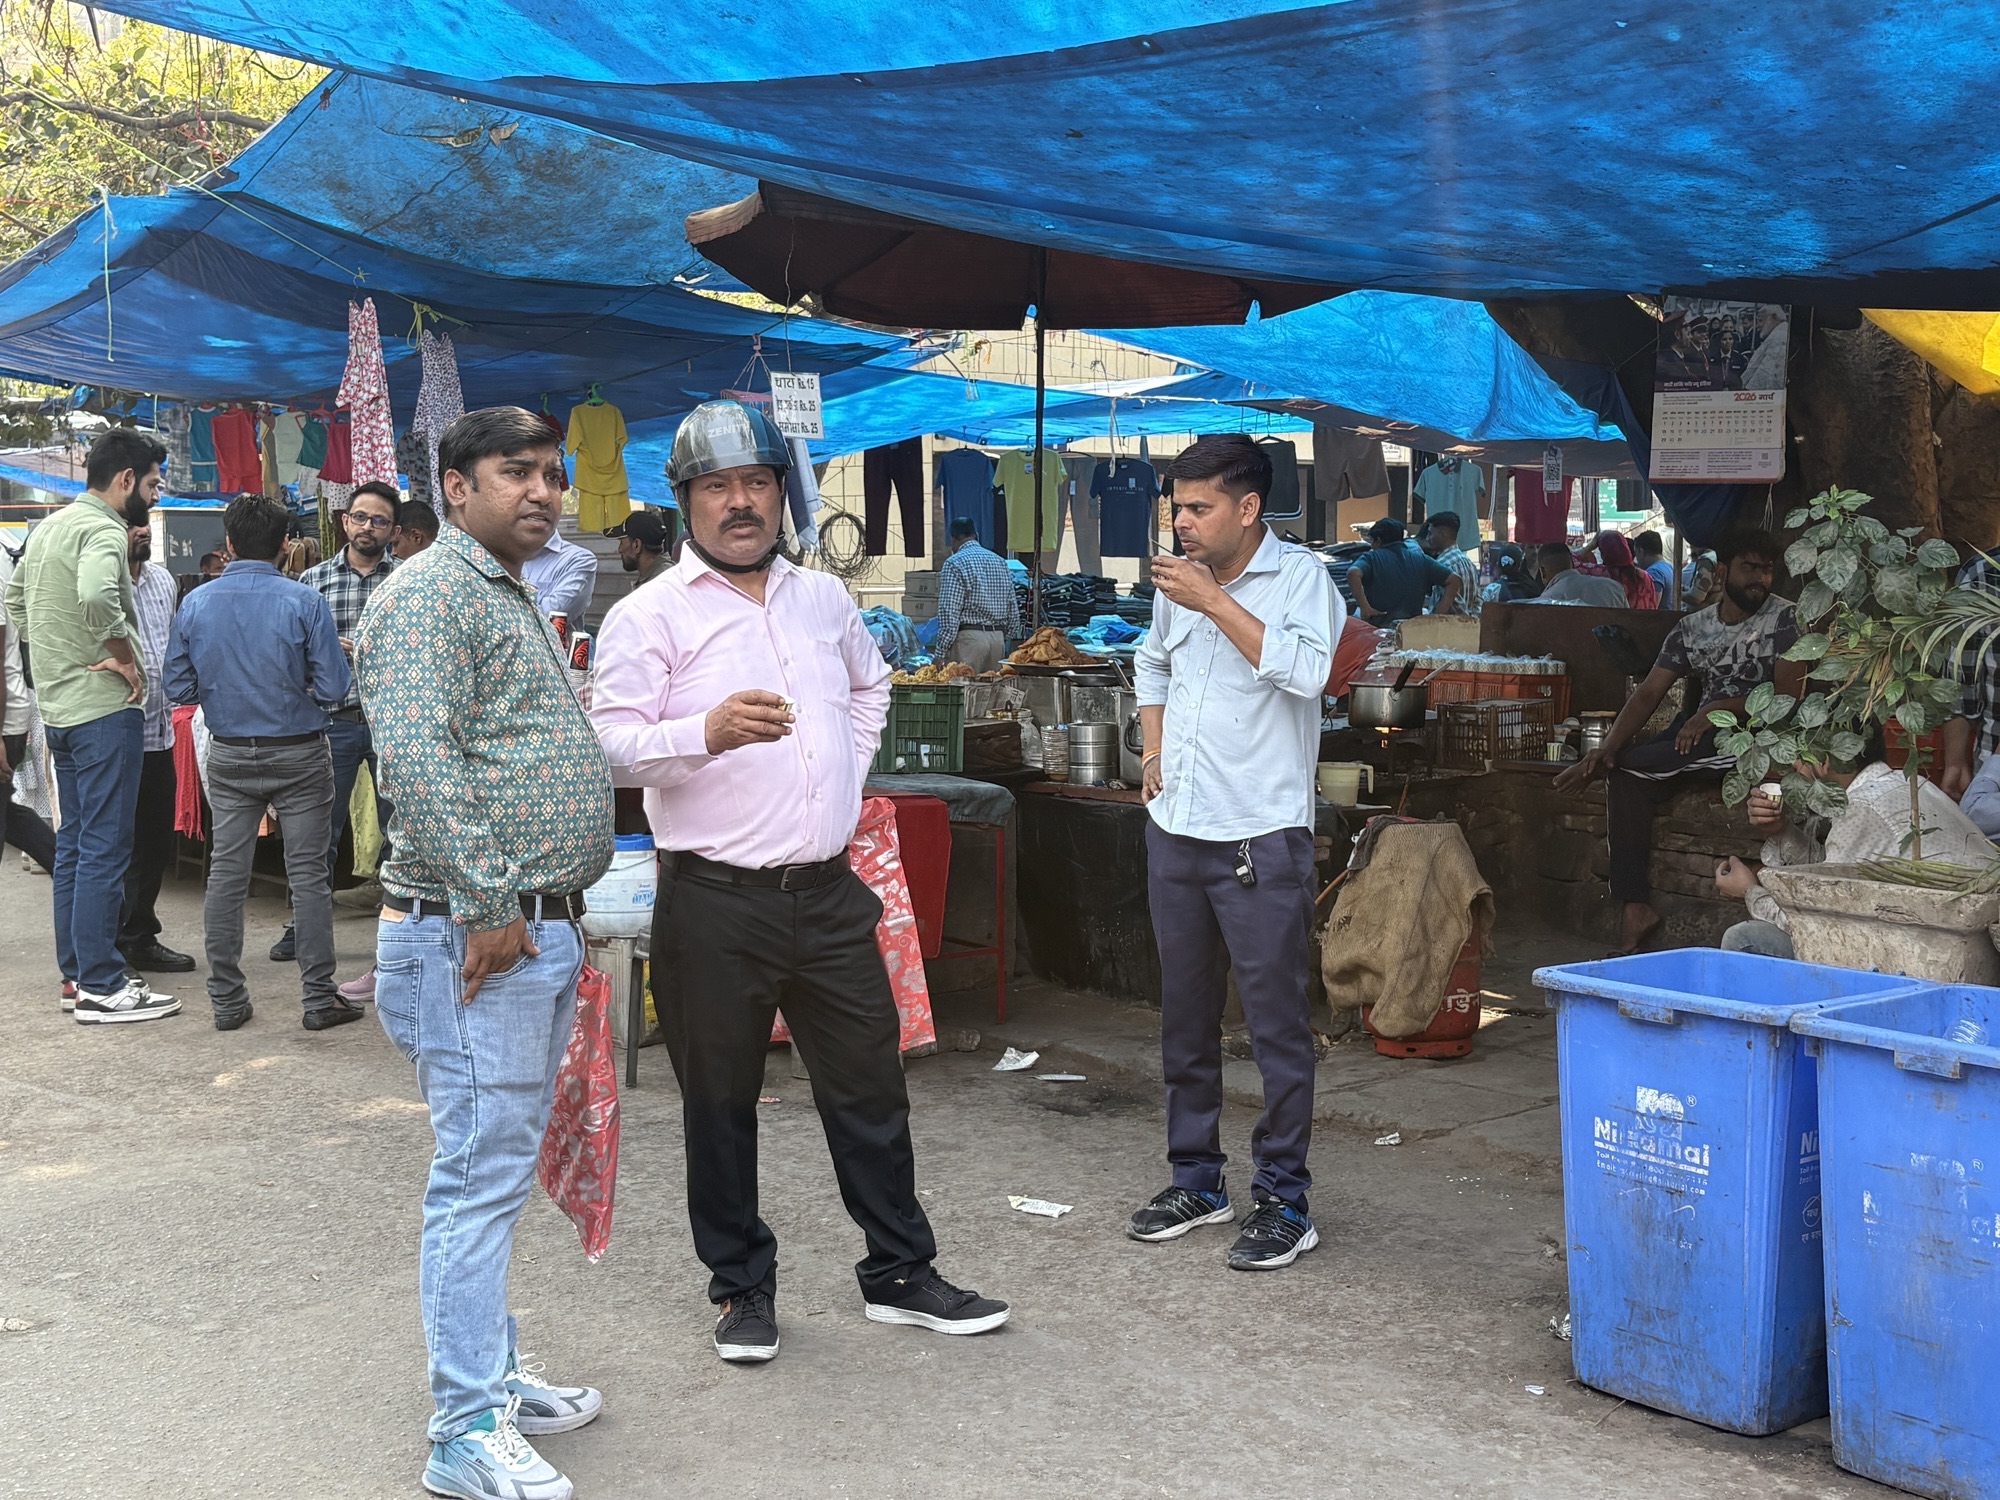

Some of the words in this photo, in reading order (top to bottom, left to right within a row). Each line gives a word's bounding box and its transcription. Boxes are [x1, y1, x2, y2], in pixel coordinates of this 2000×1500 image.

[807, 378, 815, 390] 15
[1733, 392, 1757, 402] 2026
[1758, 392, 1776, 401] मार्च
